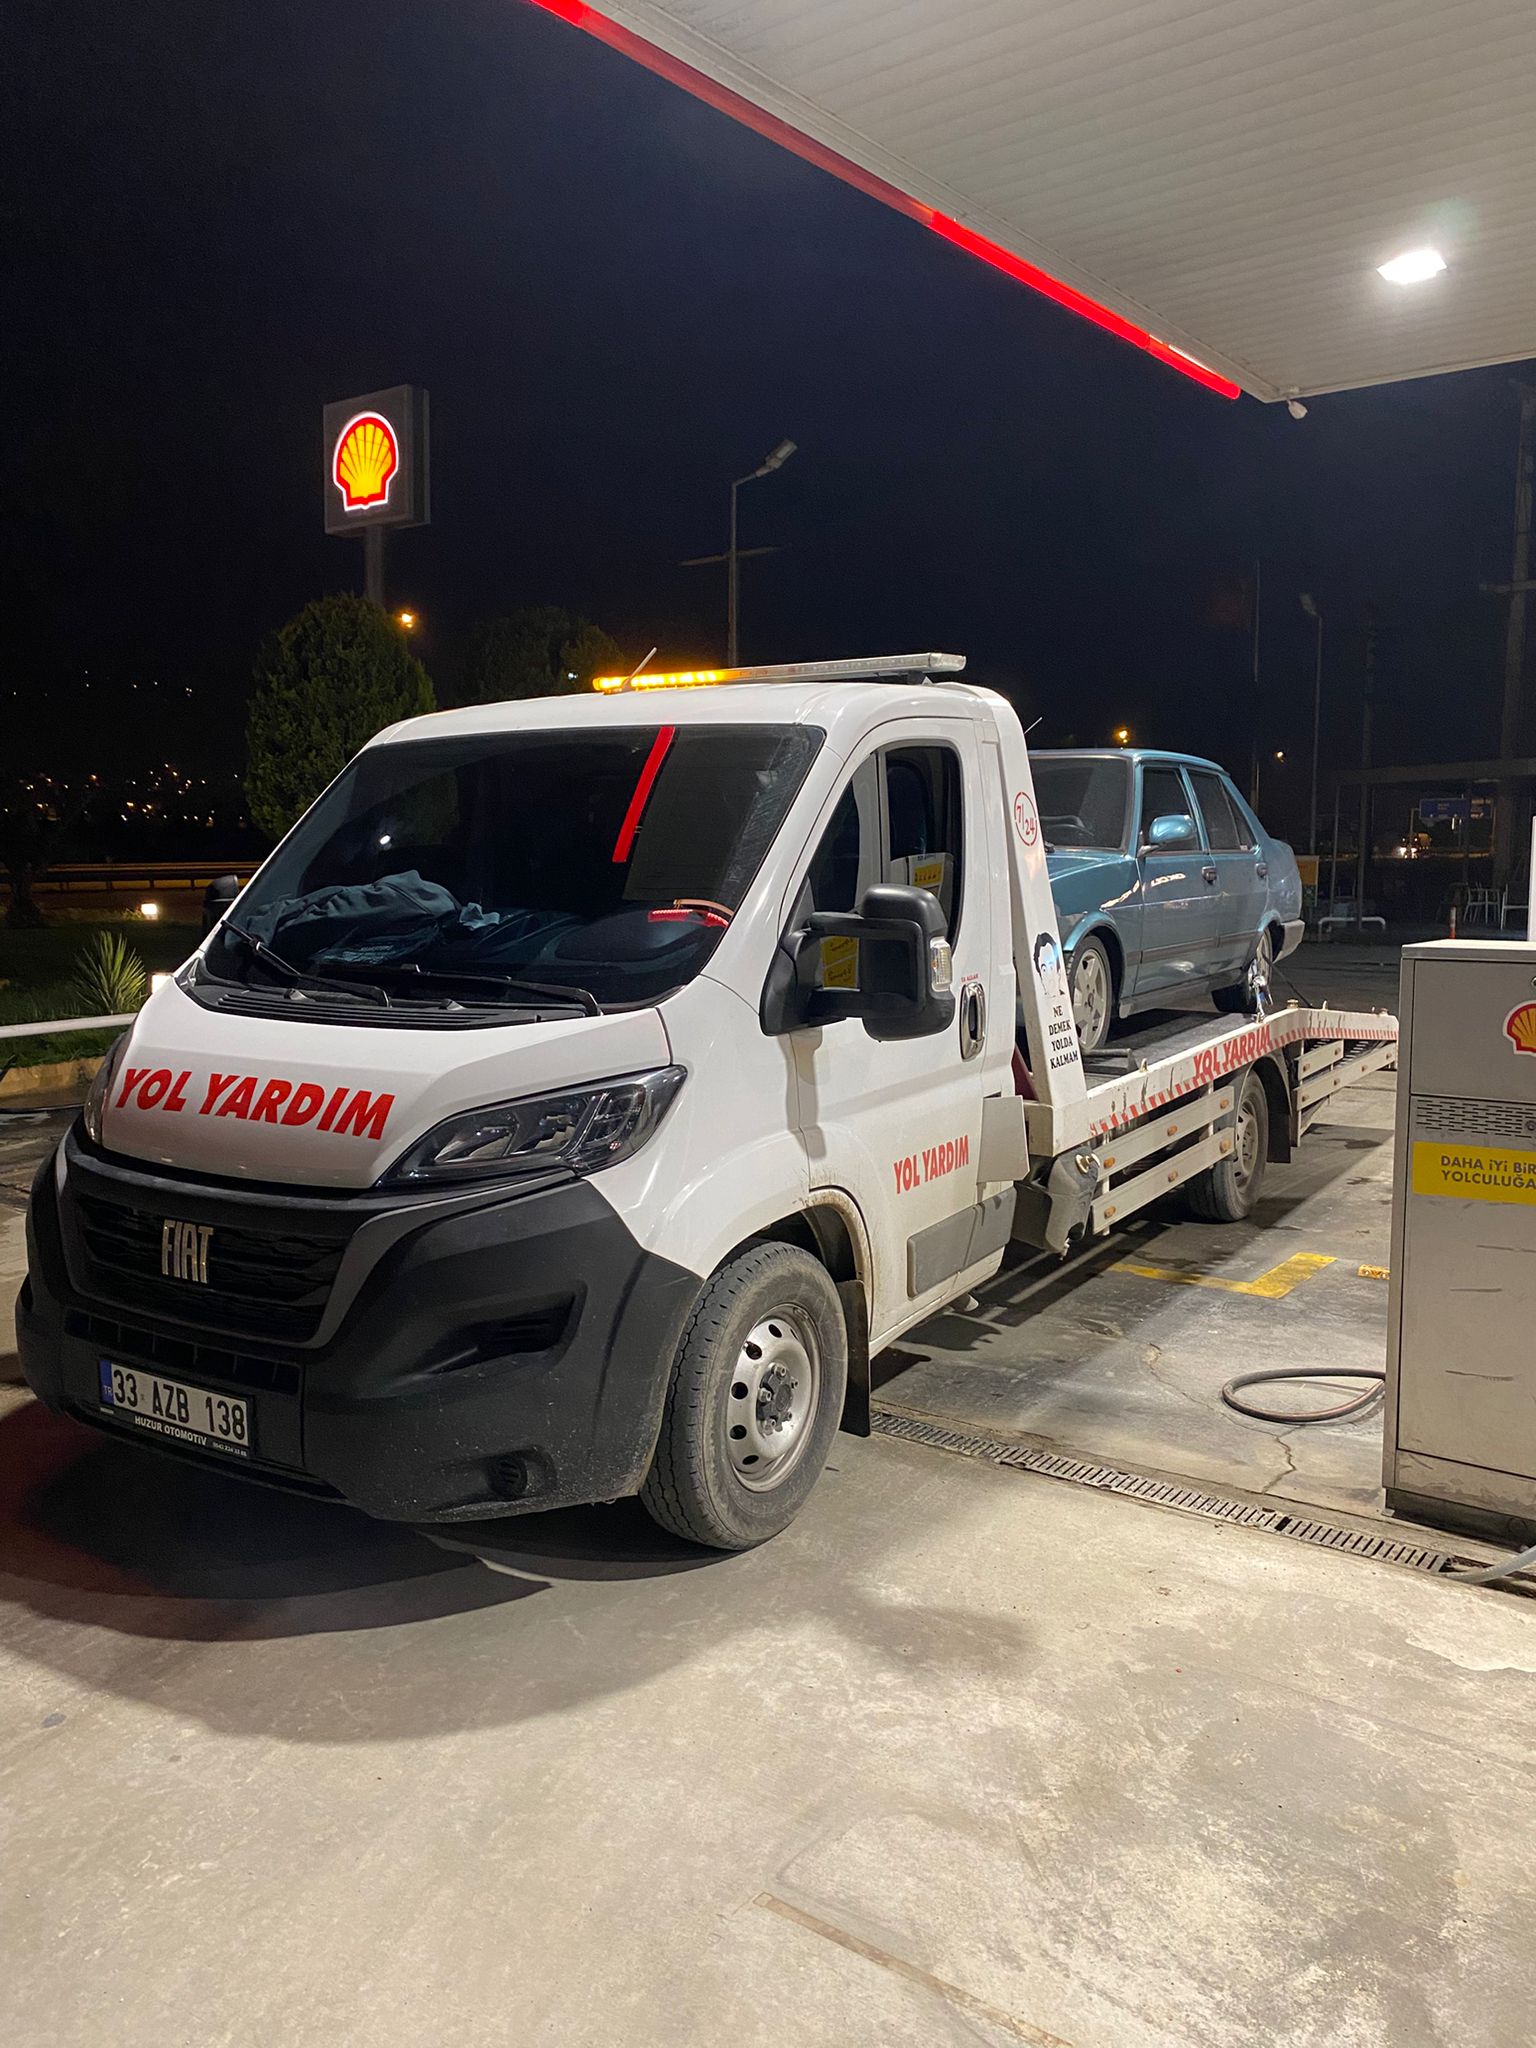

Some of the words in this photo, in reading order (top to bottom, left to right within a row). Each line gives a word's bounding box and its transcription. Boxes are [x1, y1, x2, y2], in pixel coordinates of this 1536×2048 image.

[1053, 1005, 1063, 1018] NE
[1048, 1020, 1072, 1036] DEMEK
[1051, 1036, 1074, 1052] YOLDA
[1193, 1046, 1220, 1077] YOL
[1223, 1024, 1270, 1066] YARDIM
[1050, 1050, 1079, 1070] KALMAM
[115, 1068, 193, 1111] YOL
[199, 1073, 396, 1140] YARDIM
[893, 1154, 920, 1194] YOL
[922, 1135, 969, 1182] YARDIM
[1441, 1155, 1484, 1171] DAHA
[161, 1219, 214, 1284] FIAT
[103, 1385, 114, 1397] TR
[113, 1369, 138, 1407] 33
[152, 1381, 190, 1424] AZB
[205, 1396, 246, 1440] 138
[134, 1415, 163, 1432] HUZUR
